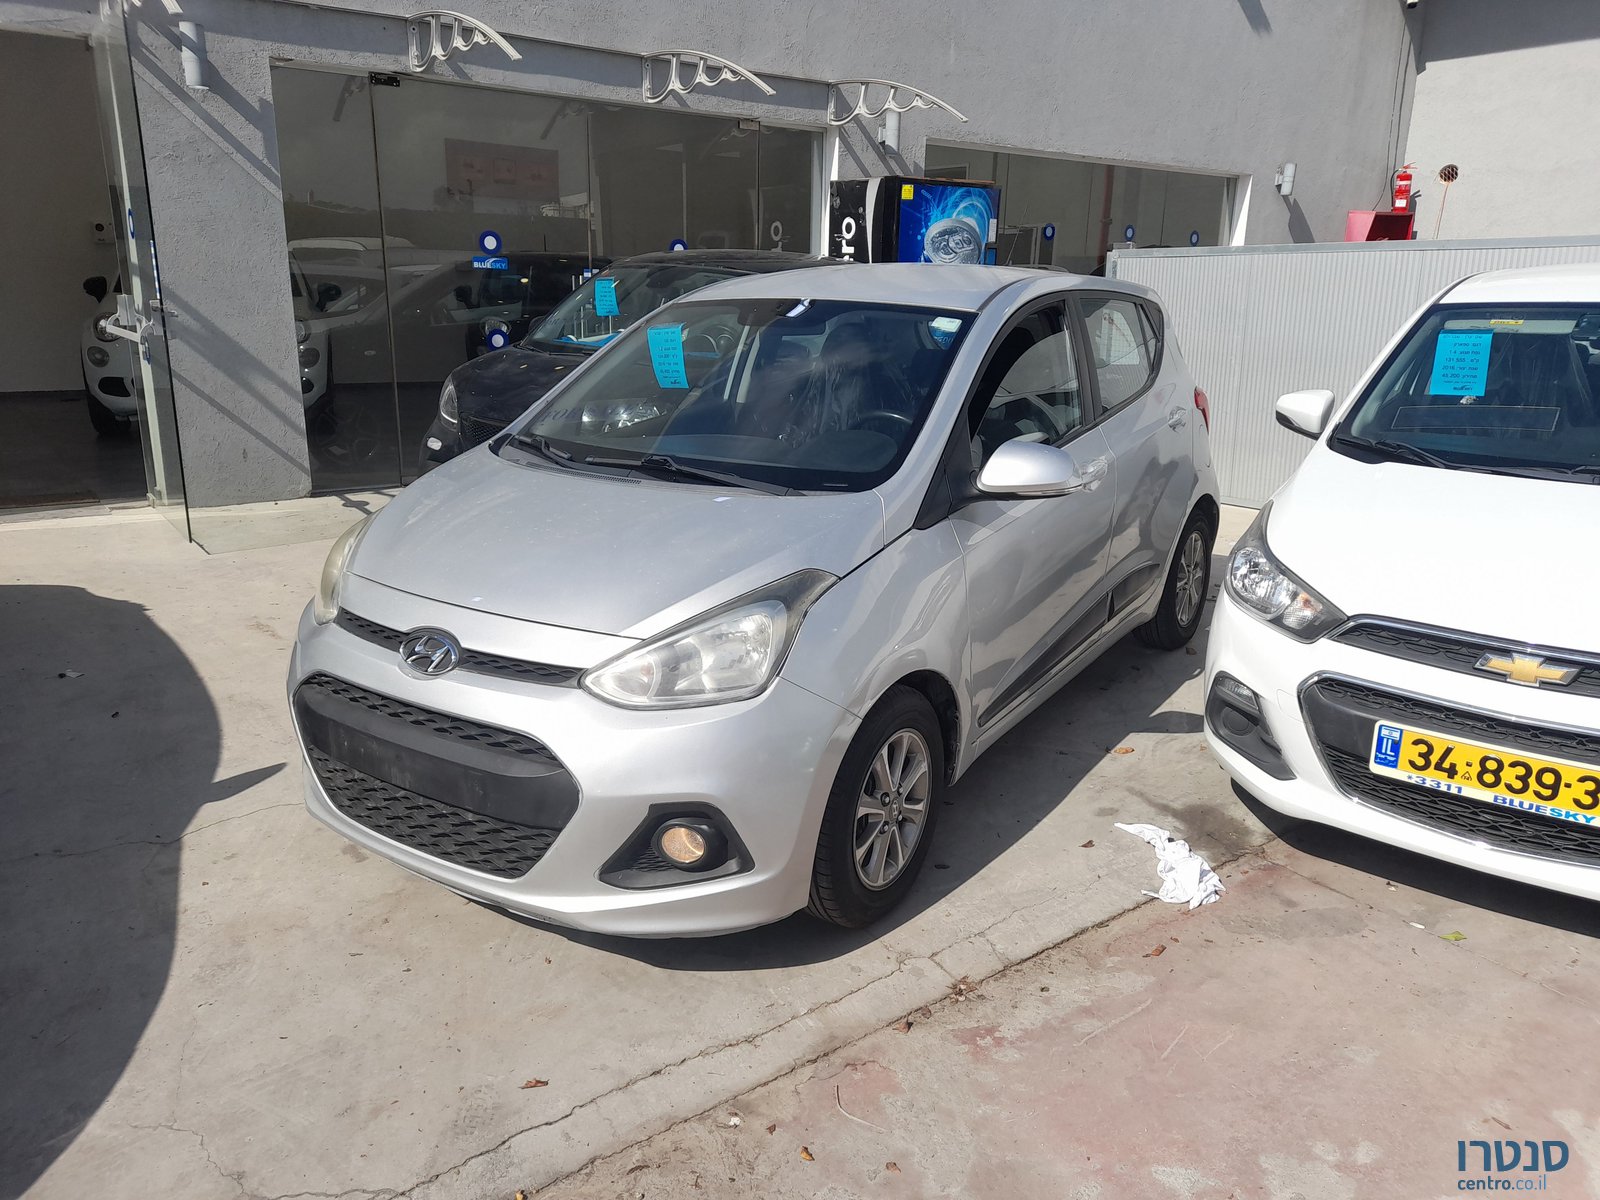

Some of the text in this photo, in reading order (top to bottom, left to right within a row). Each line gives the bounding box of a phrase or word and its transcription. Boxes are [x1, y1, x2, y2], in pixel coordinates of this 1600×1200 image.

[473, 261, 506, 269] BLUESKY
[1381, 737, 1395, 756] IL
[1492, 794, 1597, 824] BLUESKY
